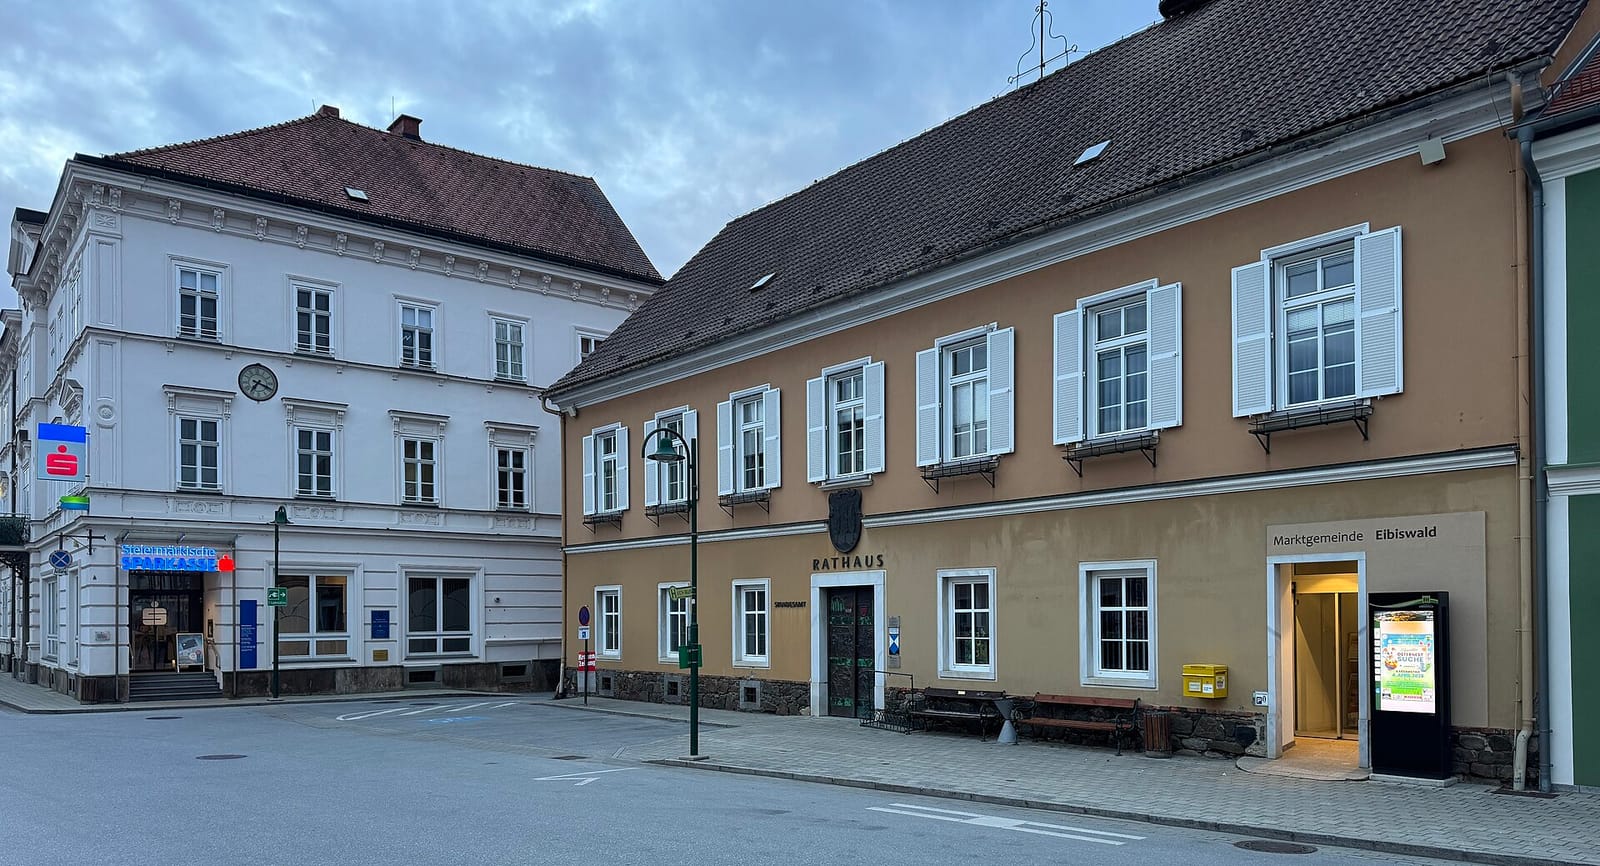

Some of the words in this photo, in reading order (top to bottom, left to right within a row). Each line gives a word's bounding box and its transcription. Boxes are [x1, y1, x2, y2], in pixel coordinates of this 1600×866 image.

[1273, 531, 1364, 547] Marktgemeinde
[1376, 526, 1437, 540] Eibiswald
[121, 544, 216, 556] Steiermärkische
[121, 557, 216, 571] SPARKASSE
[812, 554, 884, 571] RATHAUS
